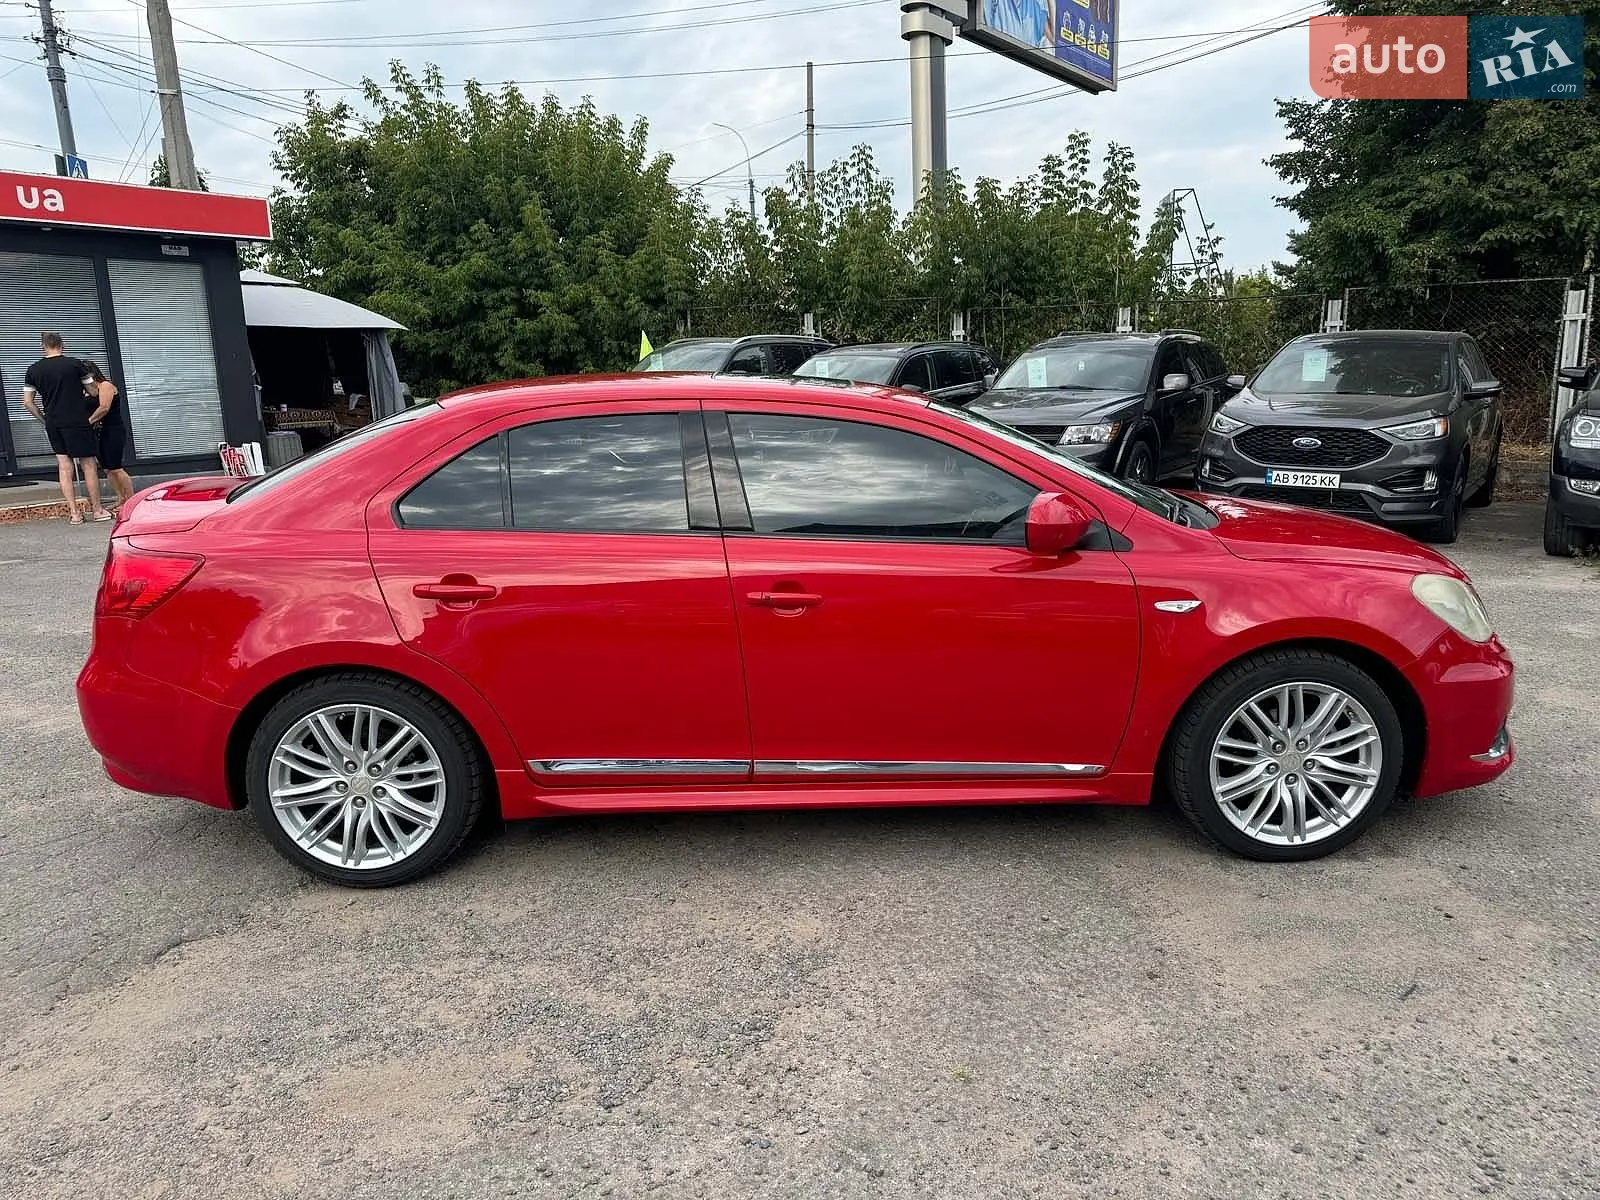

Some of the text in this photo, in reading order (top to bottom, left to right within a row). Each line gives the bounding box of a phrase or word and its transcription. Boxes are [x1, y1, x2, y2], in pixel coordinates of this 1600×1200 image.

[16, 185, 65, 212] ua
[1273, 473, 1337, 487] AB 9125 KK
